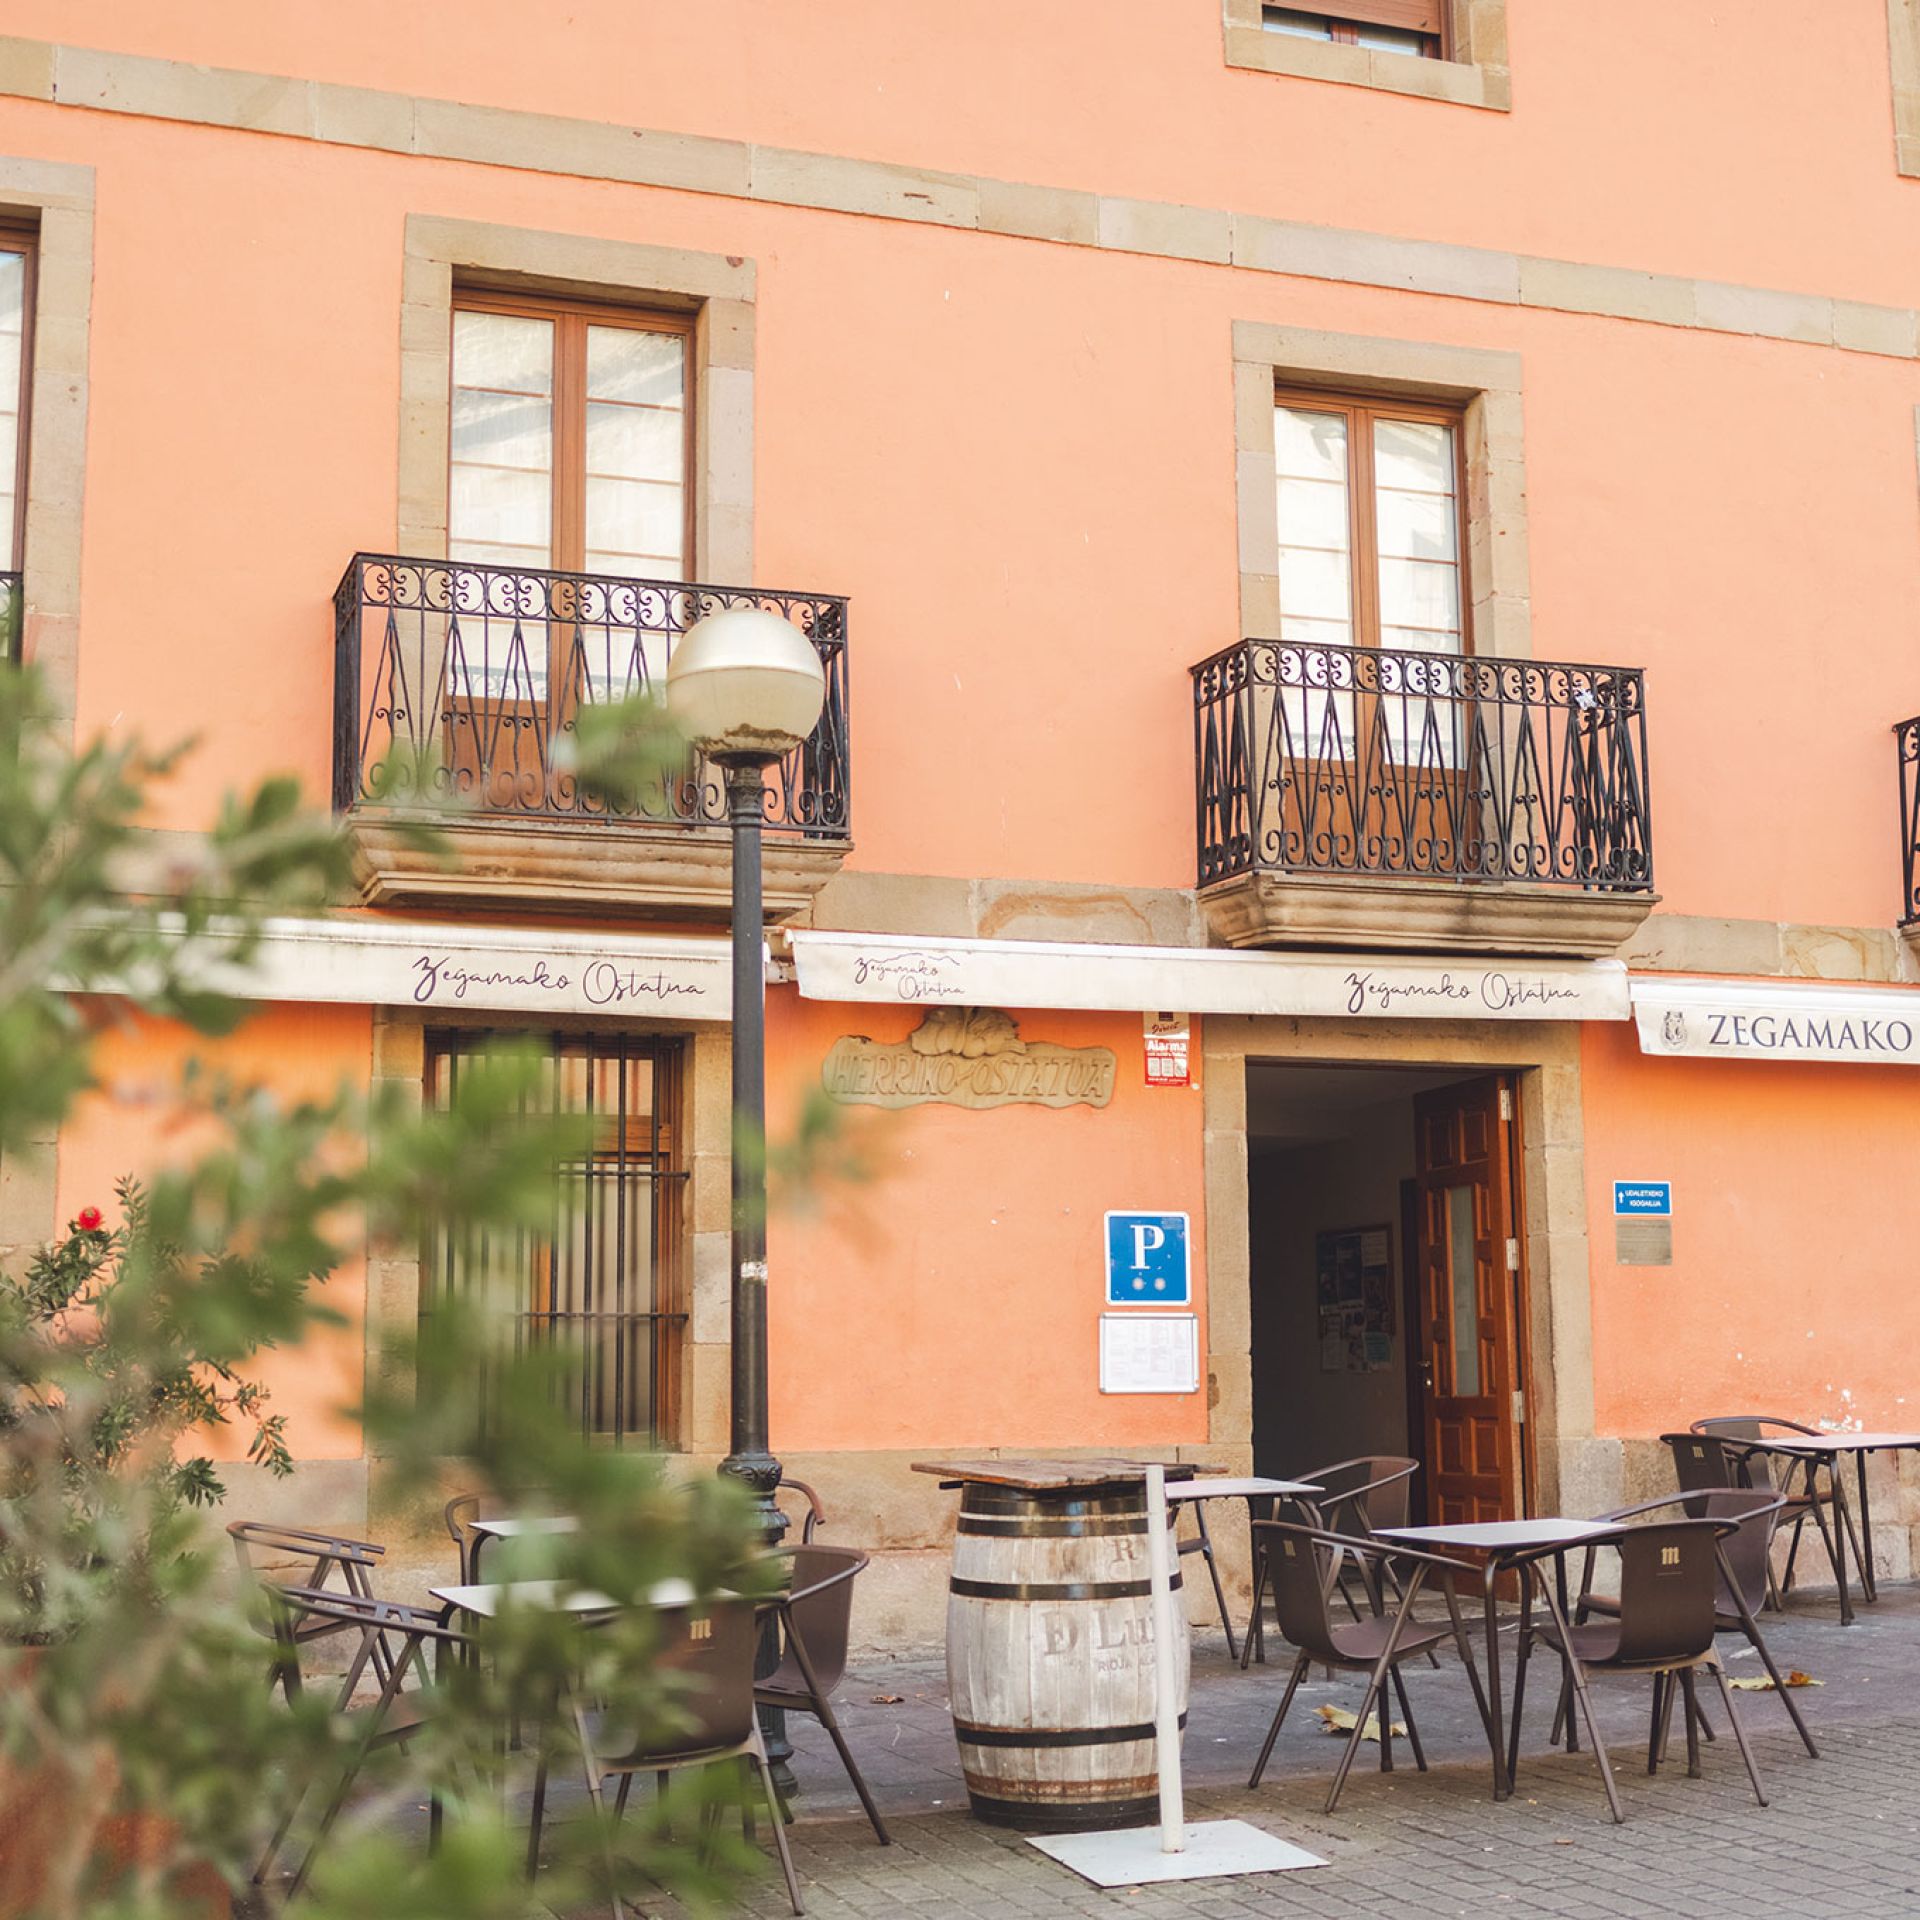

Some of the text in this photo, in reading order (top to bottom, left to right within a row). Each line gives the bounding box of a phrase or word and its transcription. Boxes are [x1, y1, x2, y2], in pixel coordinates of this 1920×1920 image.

[411, 955, 705, 1005] Zegamako Ostatua
[1344, 971, 1581, 1015] Zegamako Ostatua
[1708, 1014, 1913, 1052] ZEGAMAKO
[1129, 1224, 1165, 1270] P
